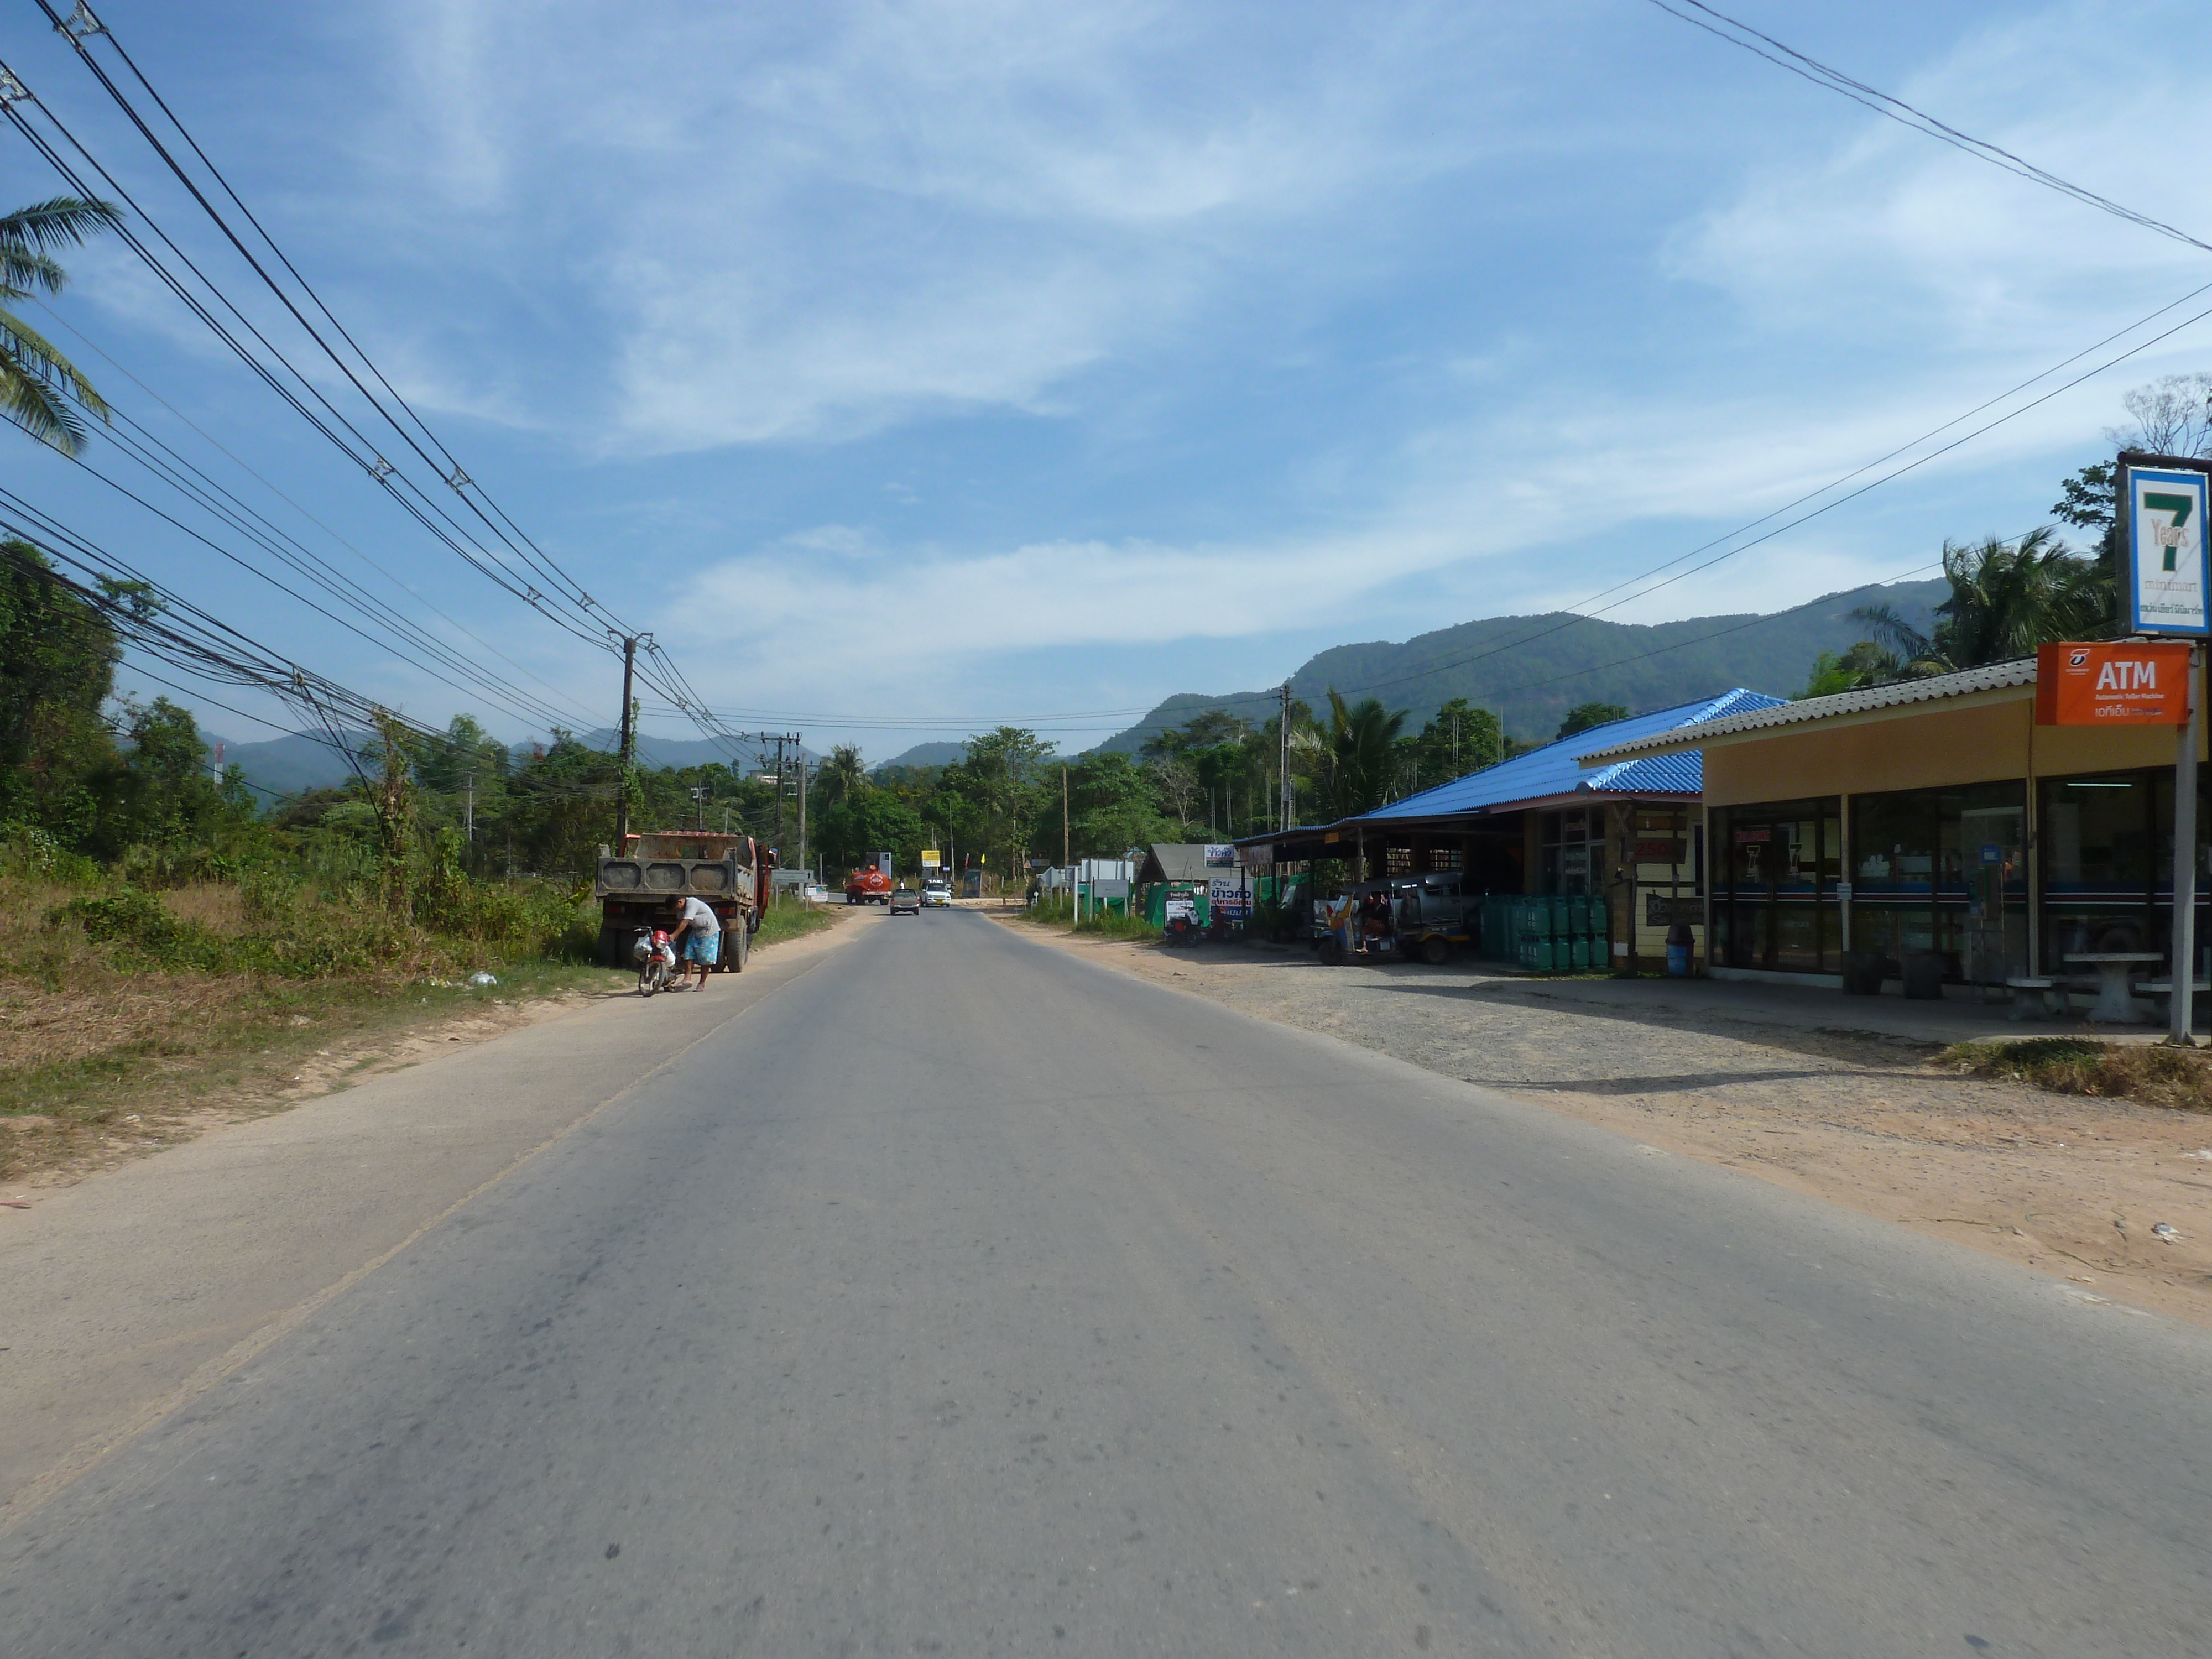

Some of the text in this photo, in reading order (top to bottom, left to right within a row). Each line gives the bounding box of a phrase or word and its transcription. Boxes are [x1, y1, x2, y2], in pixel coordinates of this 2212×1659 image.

[2143, 491, 2194, 572] 7
[2151, 518, 2189, 548] Years
[2095, 661, 2156, 690] ATM
[1212, 879, 1230, 887] ร้าน
